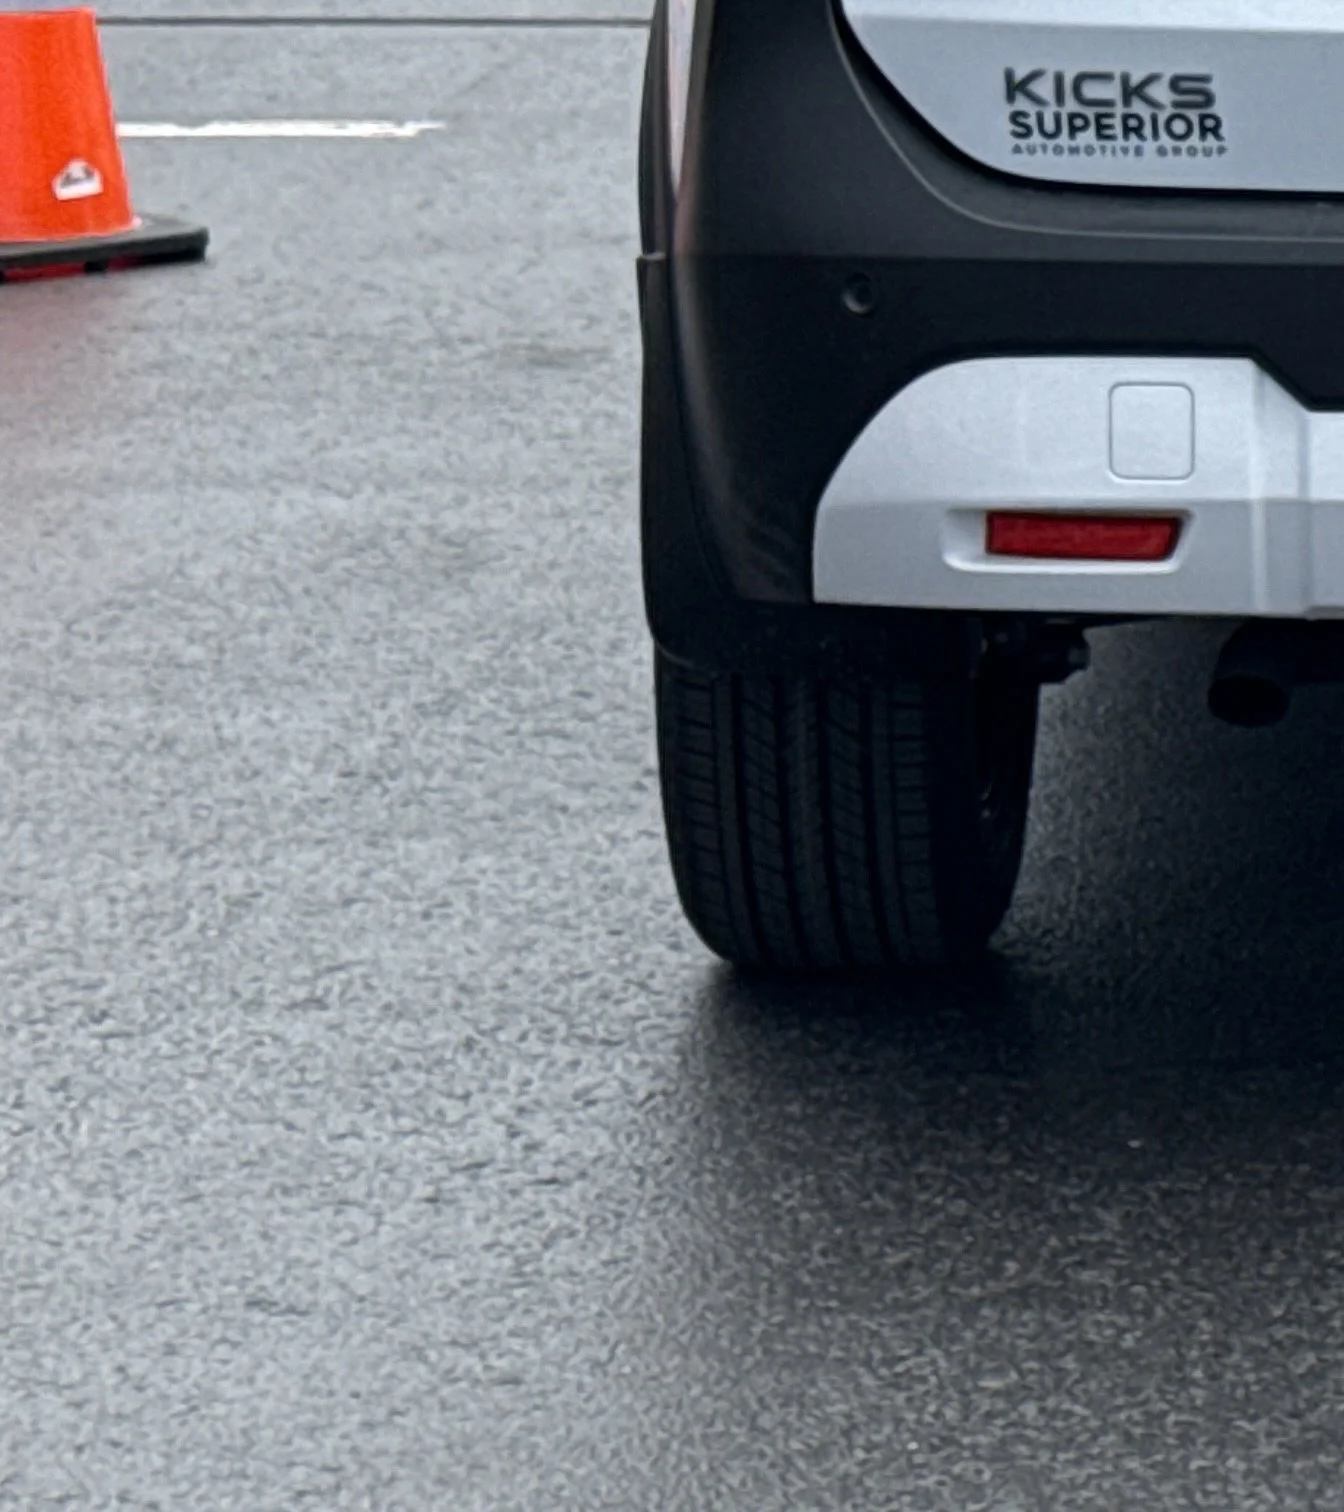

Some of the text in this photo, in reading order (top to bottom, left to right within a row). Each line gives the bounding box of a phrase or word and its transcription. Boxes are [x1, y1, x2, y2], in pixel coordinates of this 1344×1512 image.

[1004, 67, 1216, 111] KICKS
[1009, 110, 1225, 142] SUPERIOR
[1011, 143, 1228, 157] AUTOMOTIVE GROUP
